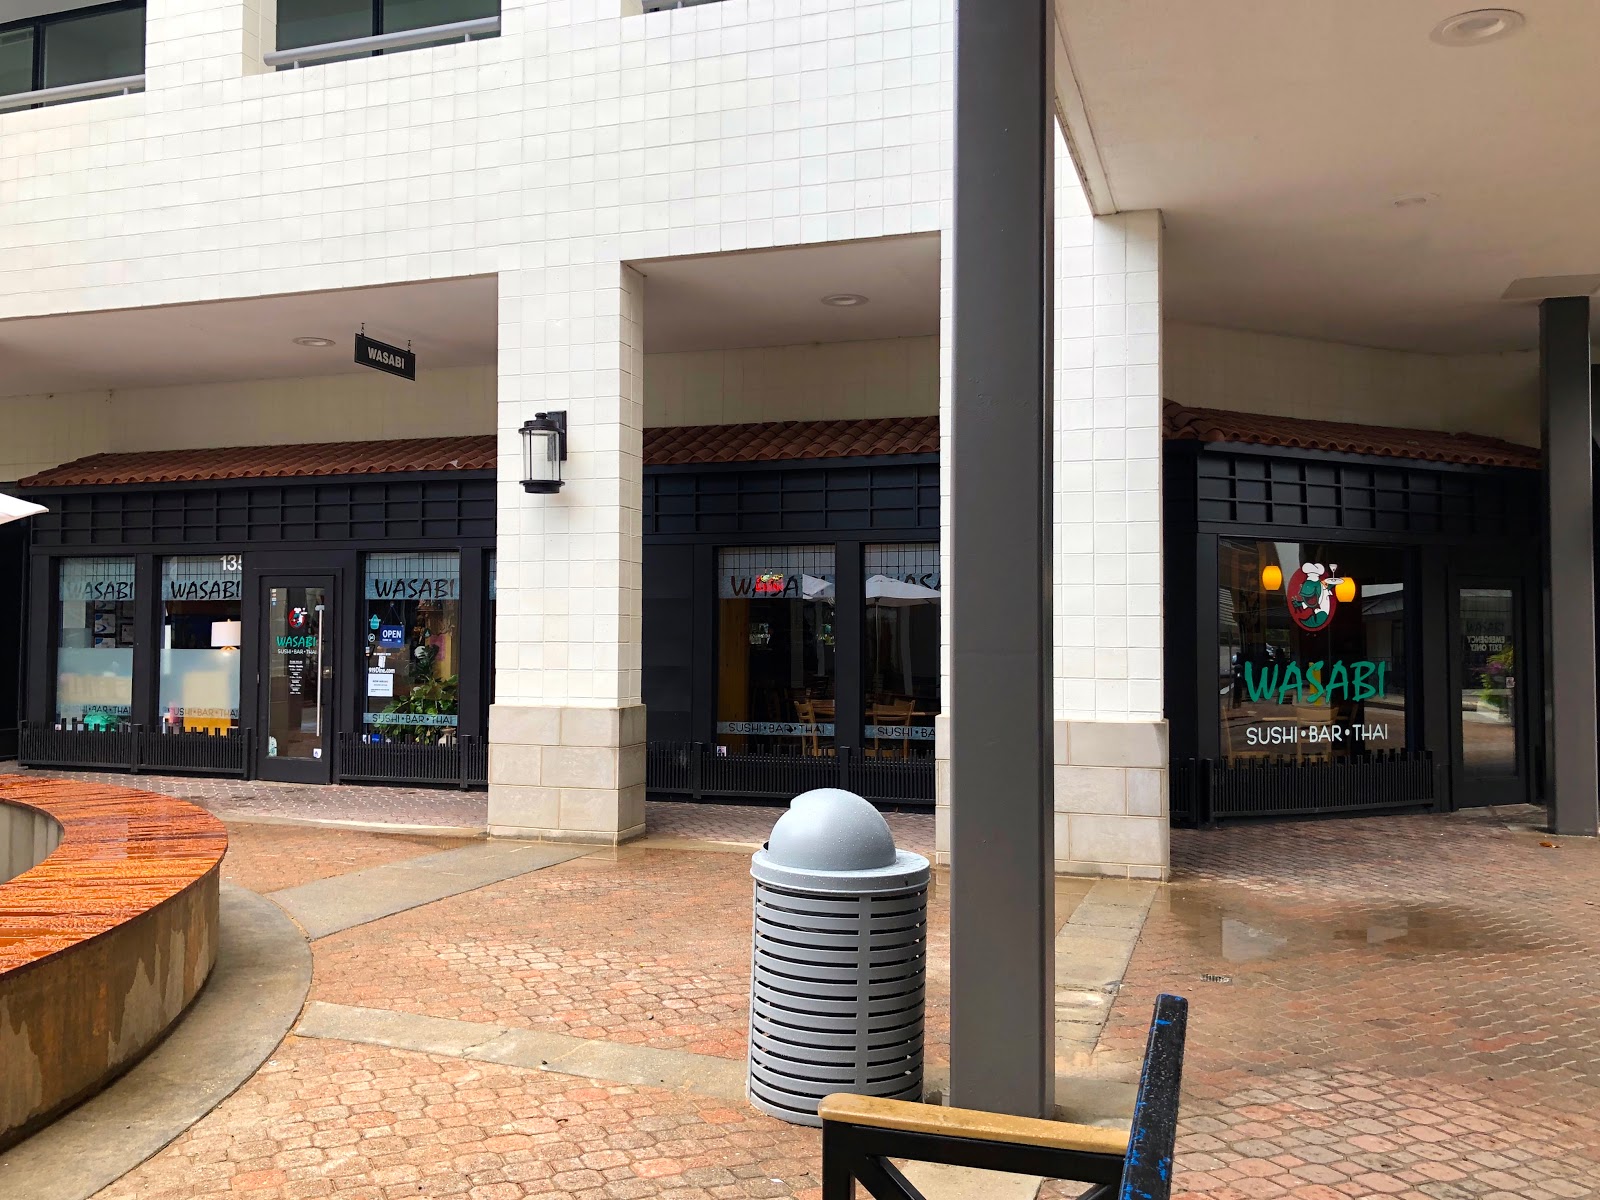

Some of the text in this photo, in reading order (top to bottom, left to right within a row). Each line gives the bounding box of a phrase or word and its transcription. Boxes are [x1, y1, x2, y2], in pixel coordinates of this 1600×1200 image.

[367, 346, 405, 370] WASABI
[171, 580, 241, 600] WASABI
[375, 578, 455, 599] WASABI
[382, 629, 402, 639] OPEN
[276, 635, 317, 648] WASABI
[1244, 660, 1386, 705] WASABI
[167, 707, 239, 718] USHI BAR THAI
[372, 713, 453, 725] SUSHI BAR THAI
[728, 722, 761, 733] SUSHI
[799, 724, 825, 735] THAI
[877, 726, 913, 737] SUSHI
[1246, 723, 1388, 746] SUSHI BAR THAI
